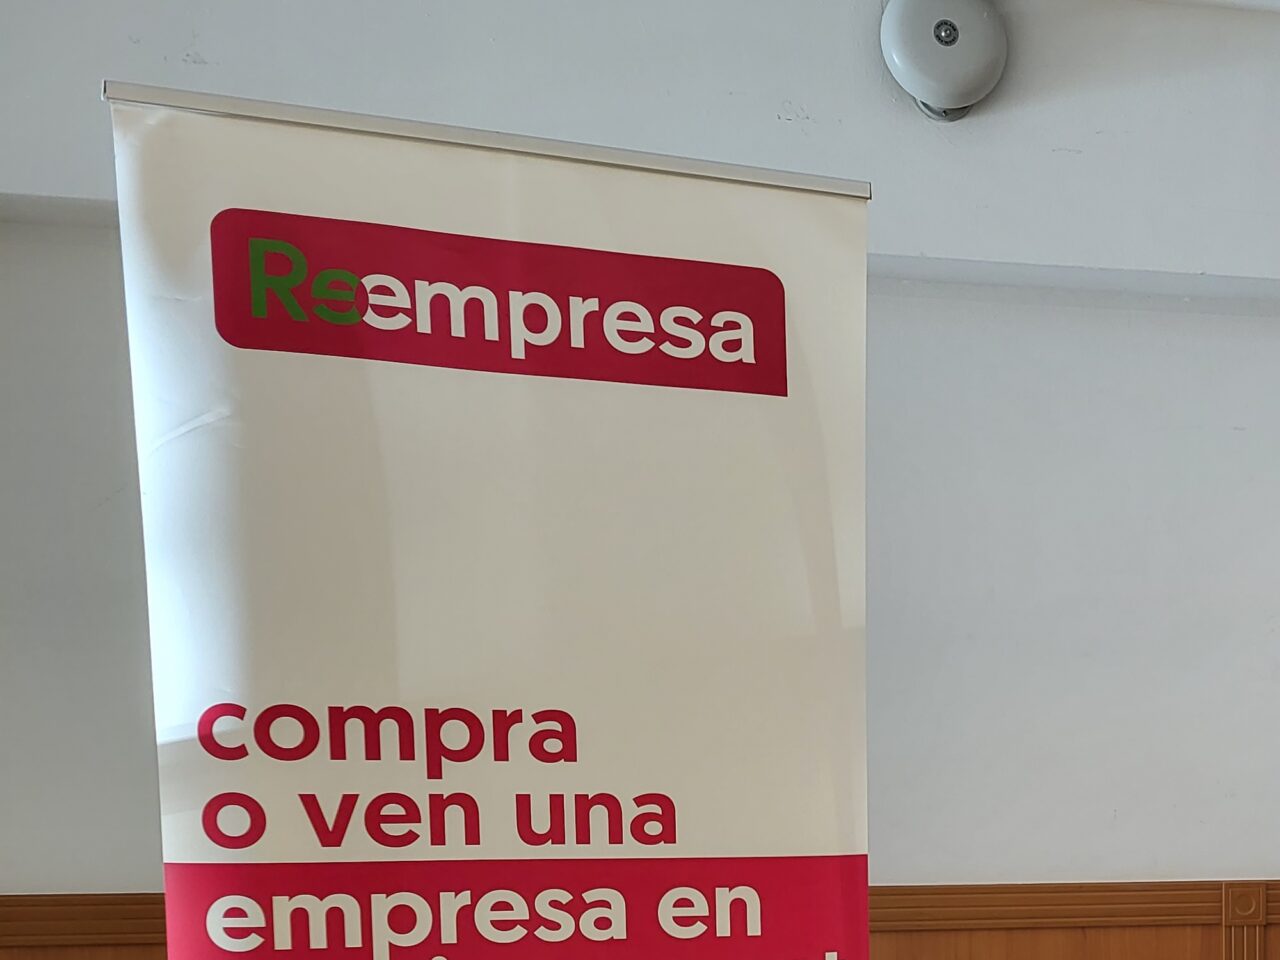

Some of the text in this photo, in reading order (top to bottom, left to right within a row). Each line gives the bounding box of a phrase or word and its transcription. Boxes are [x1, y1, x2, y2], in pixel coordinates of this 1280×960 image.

[248, 238, 756, 363] Reempresa
[197, 703, 578, 780] compra
[202, 791, 677, 849] o ven una
[657, 885, 762, 939] en
